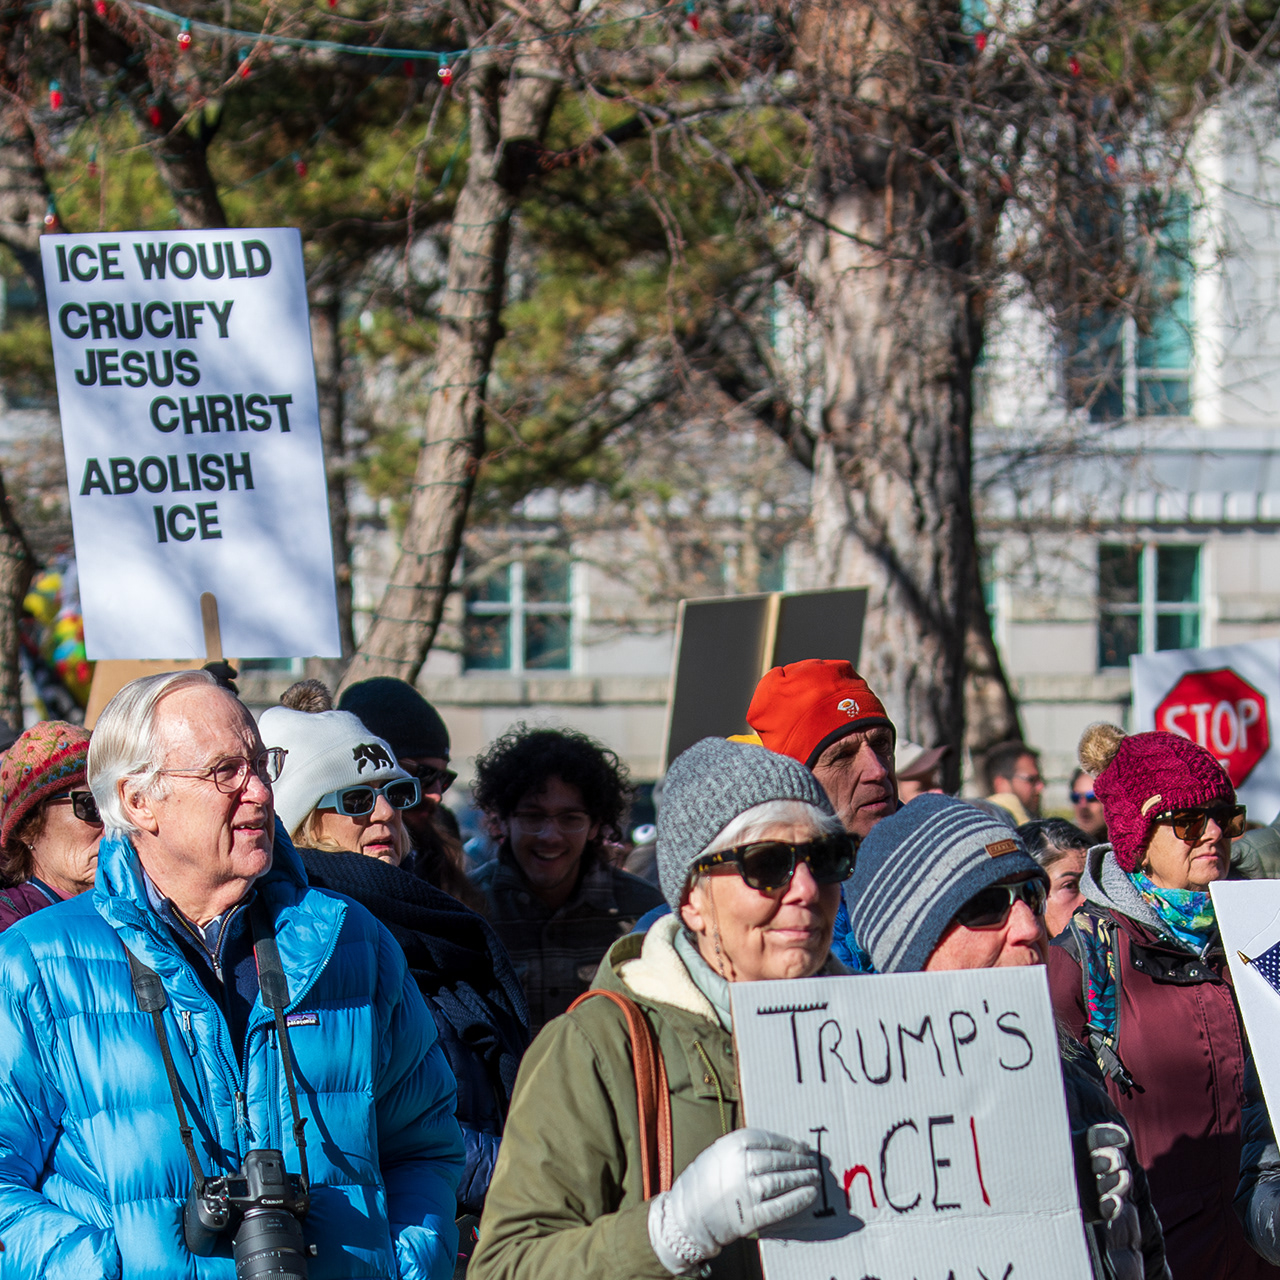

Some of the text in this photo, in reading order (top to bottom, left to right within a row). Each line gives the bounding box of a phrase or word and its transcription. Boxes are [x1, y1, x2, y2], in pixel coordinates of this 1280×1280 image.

[55, 239, 272, 282] ICE WOULD
[58, 299, 234, 340] CRUCIFY
[74, 348, 201, 388] JESUS
[149, 393, 293, 434] CHRIST
[79, 452, 254, 495] ABOLISH
[153, 501, 222, 543] ICE
[1163, 698, 1260, 754] STOP
[757, 1000, 1033, 1084] TRUMP'S
